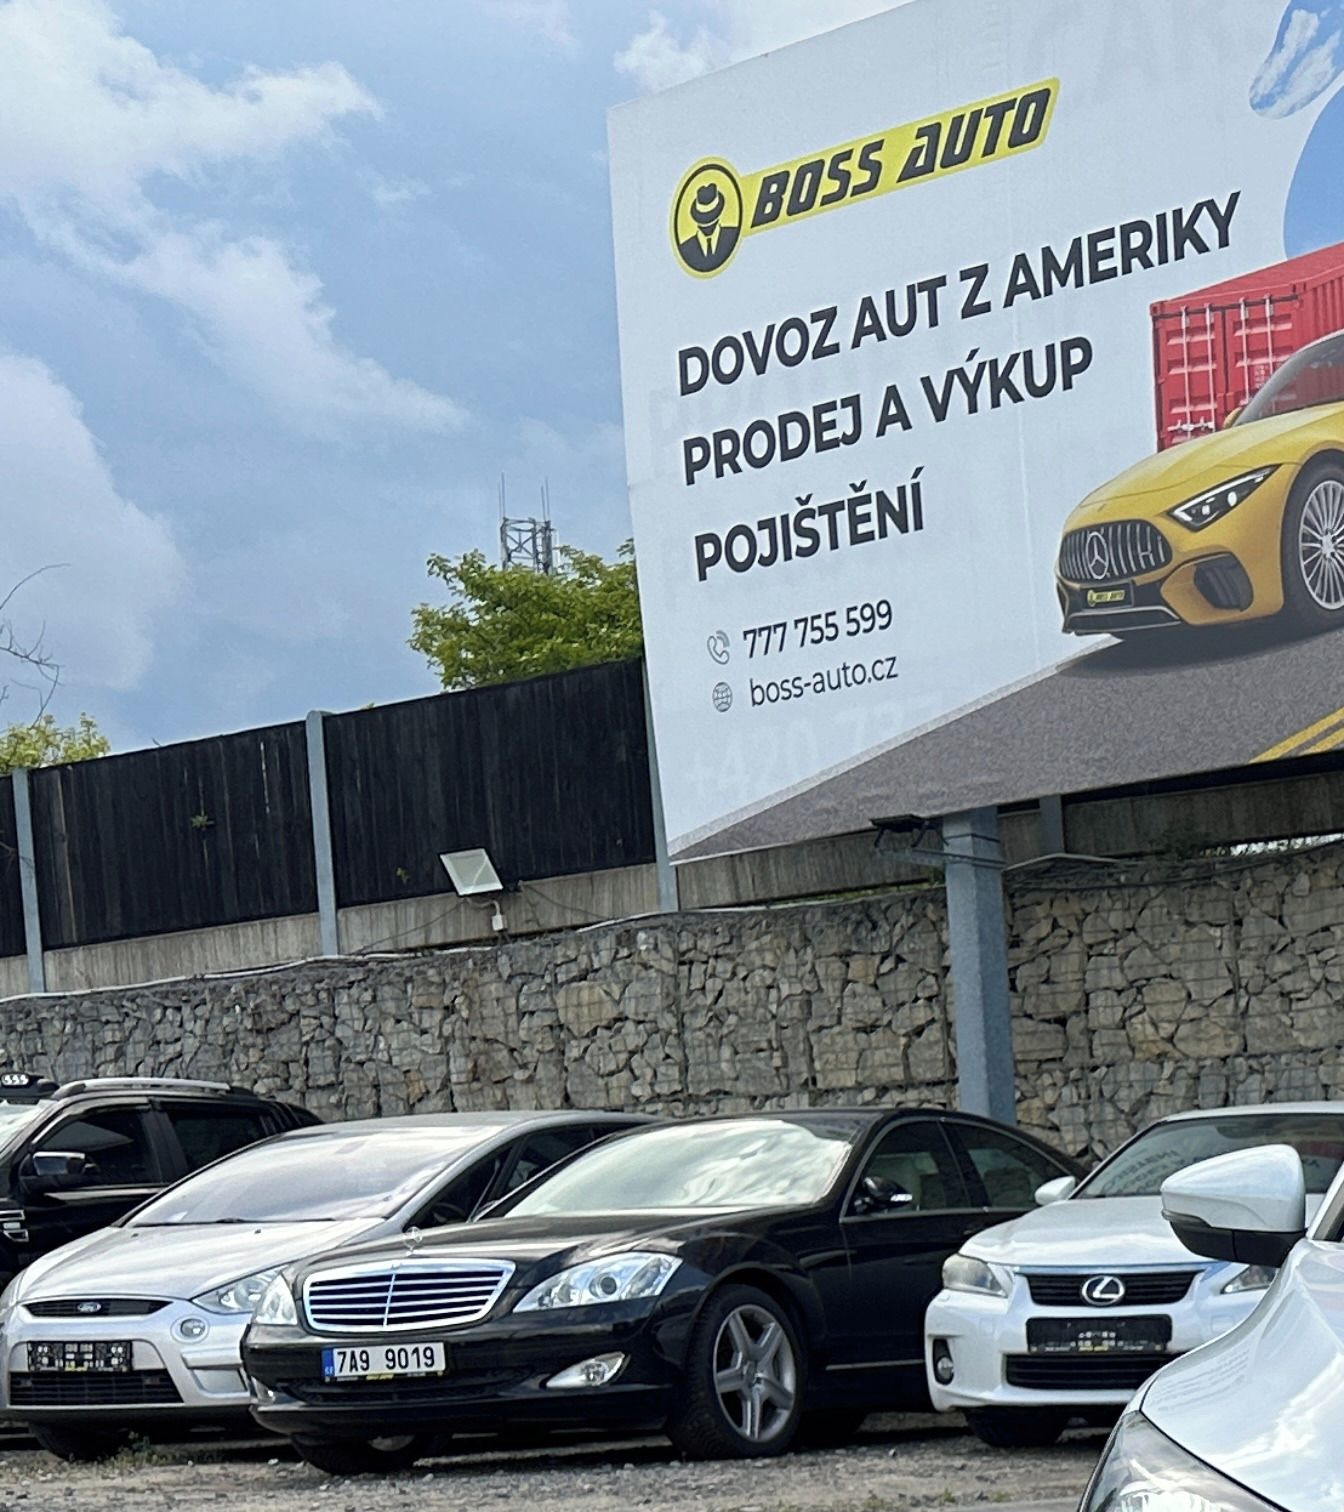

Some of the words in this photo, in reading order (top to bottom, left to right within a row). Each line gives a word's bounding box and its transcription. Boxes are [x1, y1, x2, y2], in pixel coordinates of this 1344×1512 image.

[750, 139, 886, 229] BOSS
[897, 86, 1053, 184] AUTO
[678, 305, 841, 396] DOVOZ
[851, 275, 948, 350] AUT
[960, 263, 992, 319] Z
[1003, 191, 1241, 308] AMERIKY
[682, 393, 863, 487] PRODEJ
[876, 384, 913, 438] A
[919, 336, 1094, 422] VÝKUP
[694, 465, 925, 582] POJIŠTĚNÍ
[742, 622, 788, 659] 777
[794, 611, 839, 648] 755
[846, 598, 893, 637] 599
[749, 655, 899, 708] boss-auto.cz
[337, 1350, 370, 1373] 7A9
[385, 1346, 435, 1370] 9019
